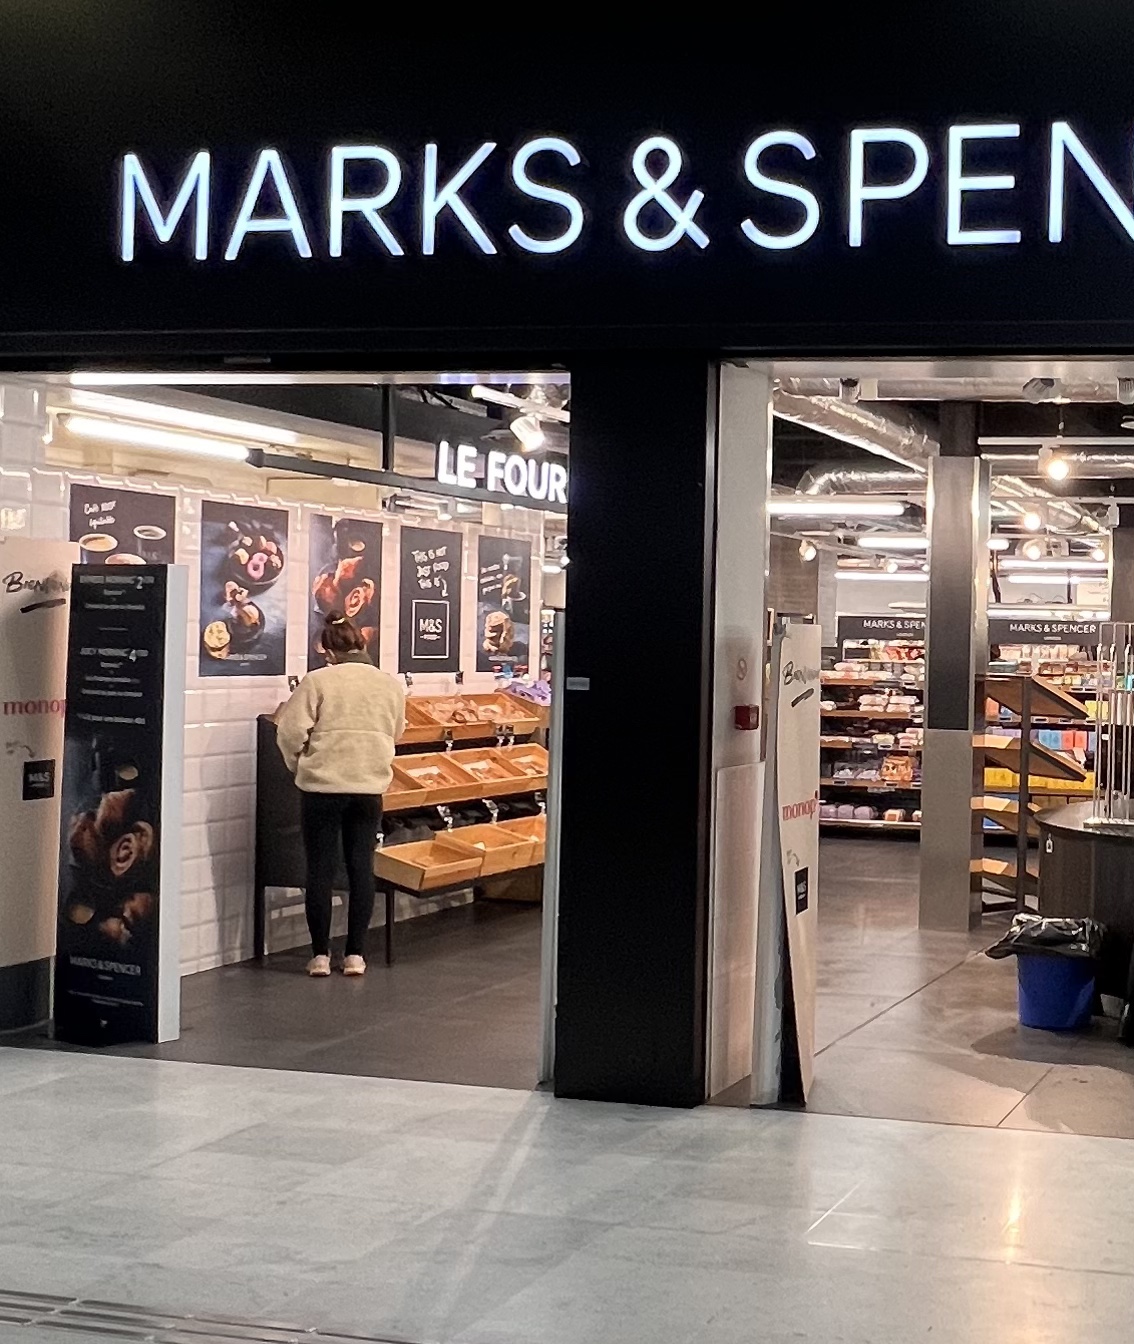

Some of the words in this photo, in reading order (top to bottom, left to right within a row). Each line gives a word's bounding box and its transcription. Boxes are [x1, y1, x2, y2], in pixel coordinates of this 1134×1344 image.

[122, 136, 584, 262] MARKS
[623, 135, 711, 253] &
[438, 440, 477, 488] LE
[487, 450, 568, 504] FOUR
[419, 618, 443, 634] M&S
[863, 619, 895, 629] MARKS
[896, 620, 903, 629] &
[1009, 623, 1042, 633] MARKS
[1043, 624, 1051, 633] &
[1052, 624, 1097, 634] SPENCER
